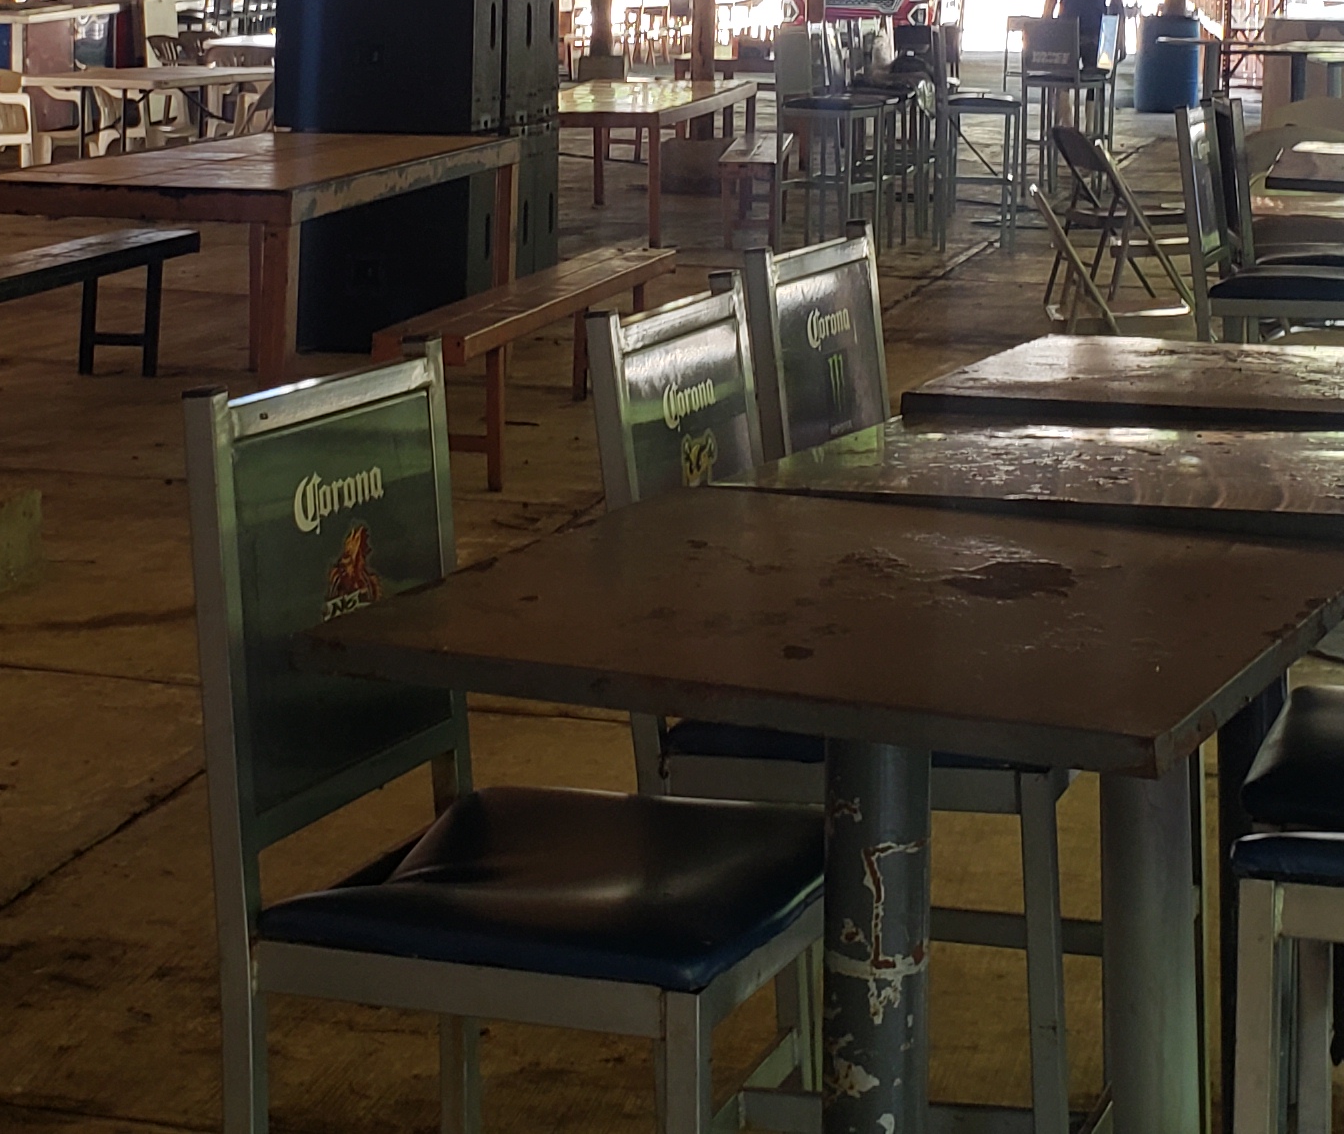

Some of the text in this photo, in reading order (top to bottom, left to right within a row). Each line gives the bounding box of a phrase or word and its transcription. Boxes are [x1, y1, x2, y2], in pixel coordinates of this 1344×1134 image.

[807, 307, 851, 352] Corona
[663, 378, 716, 433] Corona
[294, 466, 384, 535] Corona
